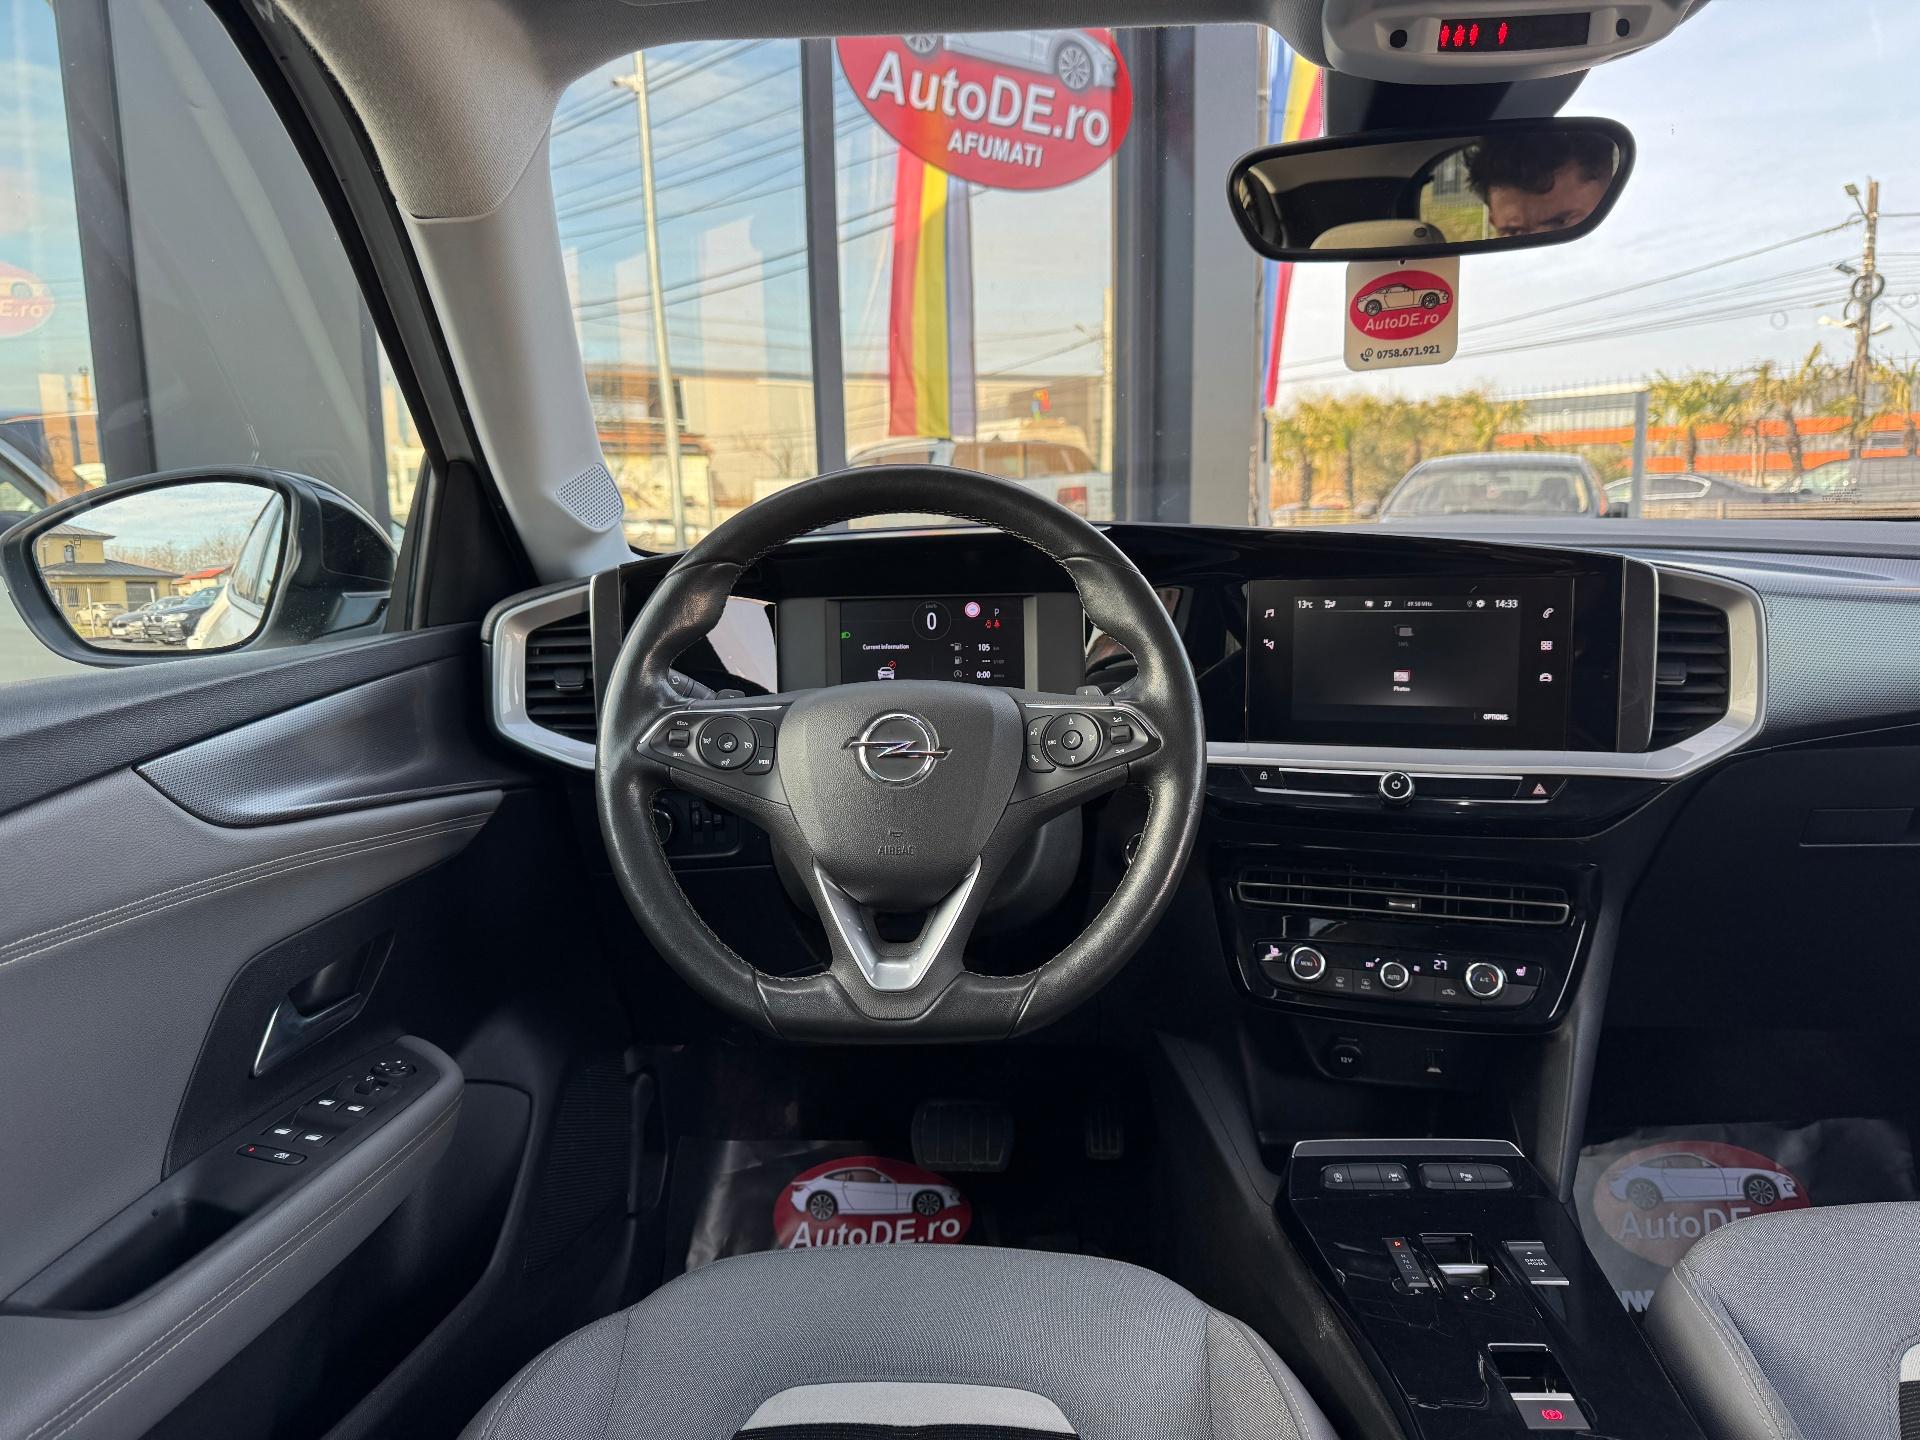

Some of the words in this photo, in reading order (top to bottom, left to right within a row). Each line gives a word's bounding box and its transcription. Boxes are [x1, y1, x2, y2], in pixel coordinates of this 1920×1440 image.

[867, 51, 1109, 146] AutoDE.ro
[948, 129, 1043, 168] AFUMATI
[1364, 313, 1439, 331] AutoDE.ro
[1377, 345, 1440, 359] 0758.671.921
[994, 608, 1000, 616] P
[1495, 600, 1518, 608] 14:33
[926, 612, 937, 630] 0
[978, 643, 990, 651] 105
[1434, 960, 1448, 971] 27
[789, 1218, 960, 1249] AutoDE.ro
